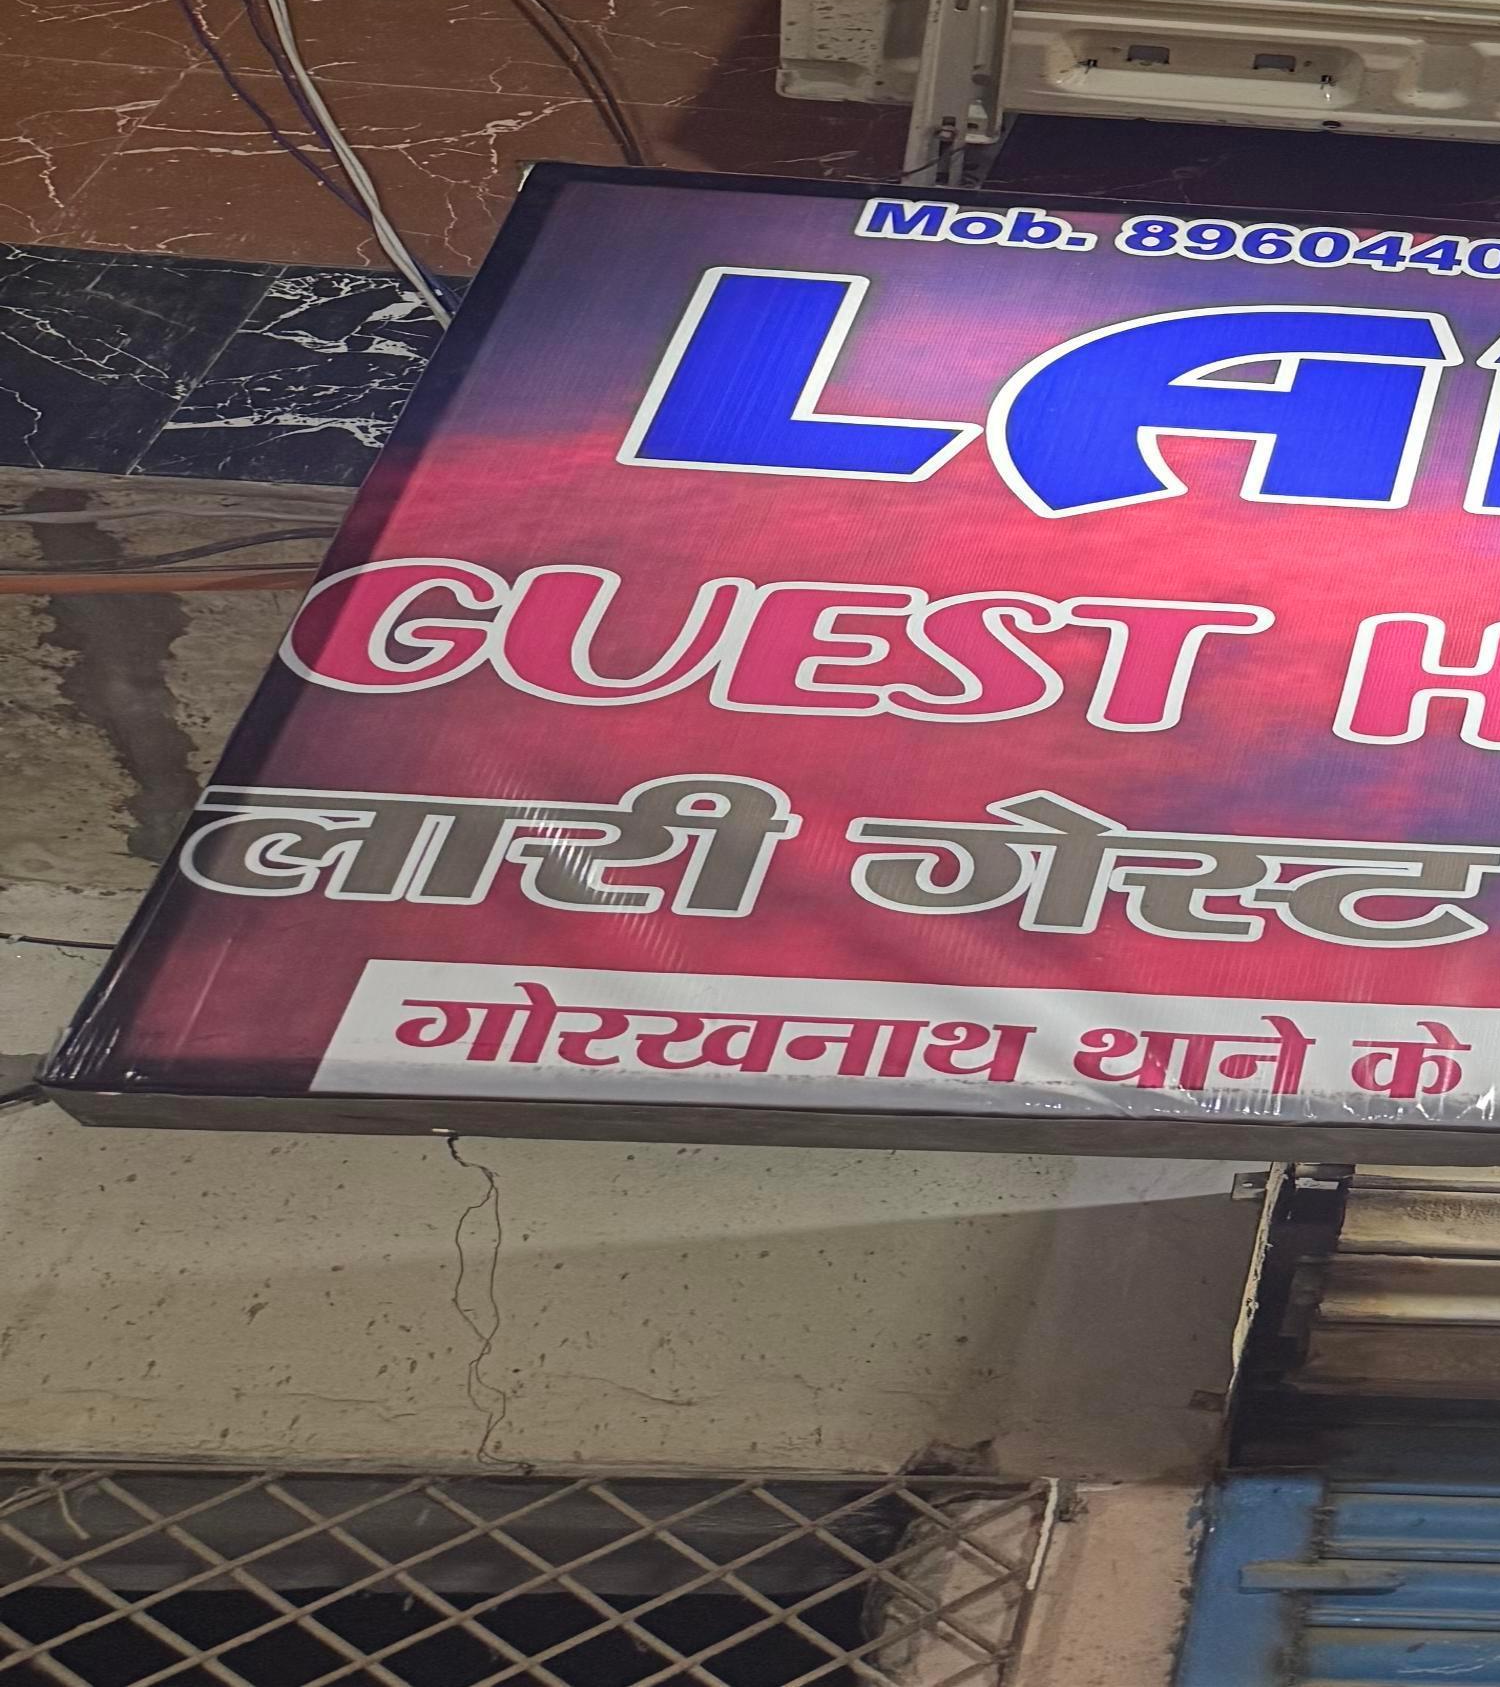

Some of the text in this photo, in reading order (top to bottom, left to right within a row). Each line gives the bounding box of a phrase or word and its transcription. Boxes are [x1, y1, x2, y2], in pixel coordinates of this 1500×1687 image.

[857, 199, 1094, 251] Mob.
[278, 557, 1275, 732] GUEST
[180, 773, 800, 918] लारी
[397, 981, 1038, 1083] गोरखनाथ
[1073, 1014, 1316, 1096] थाने
[1351, 1020, 1472, 1099] के
